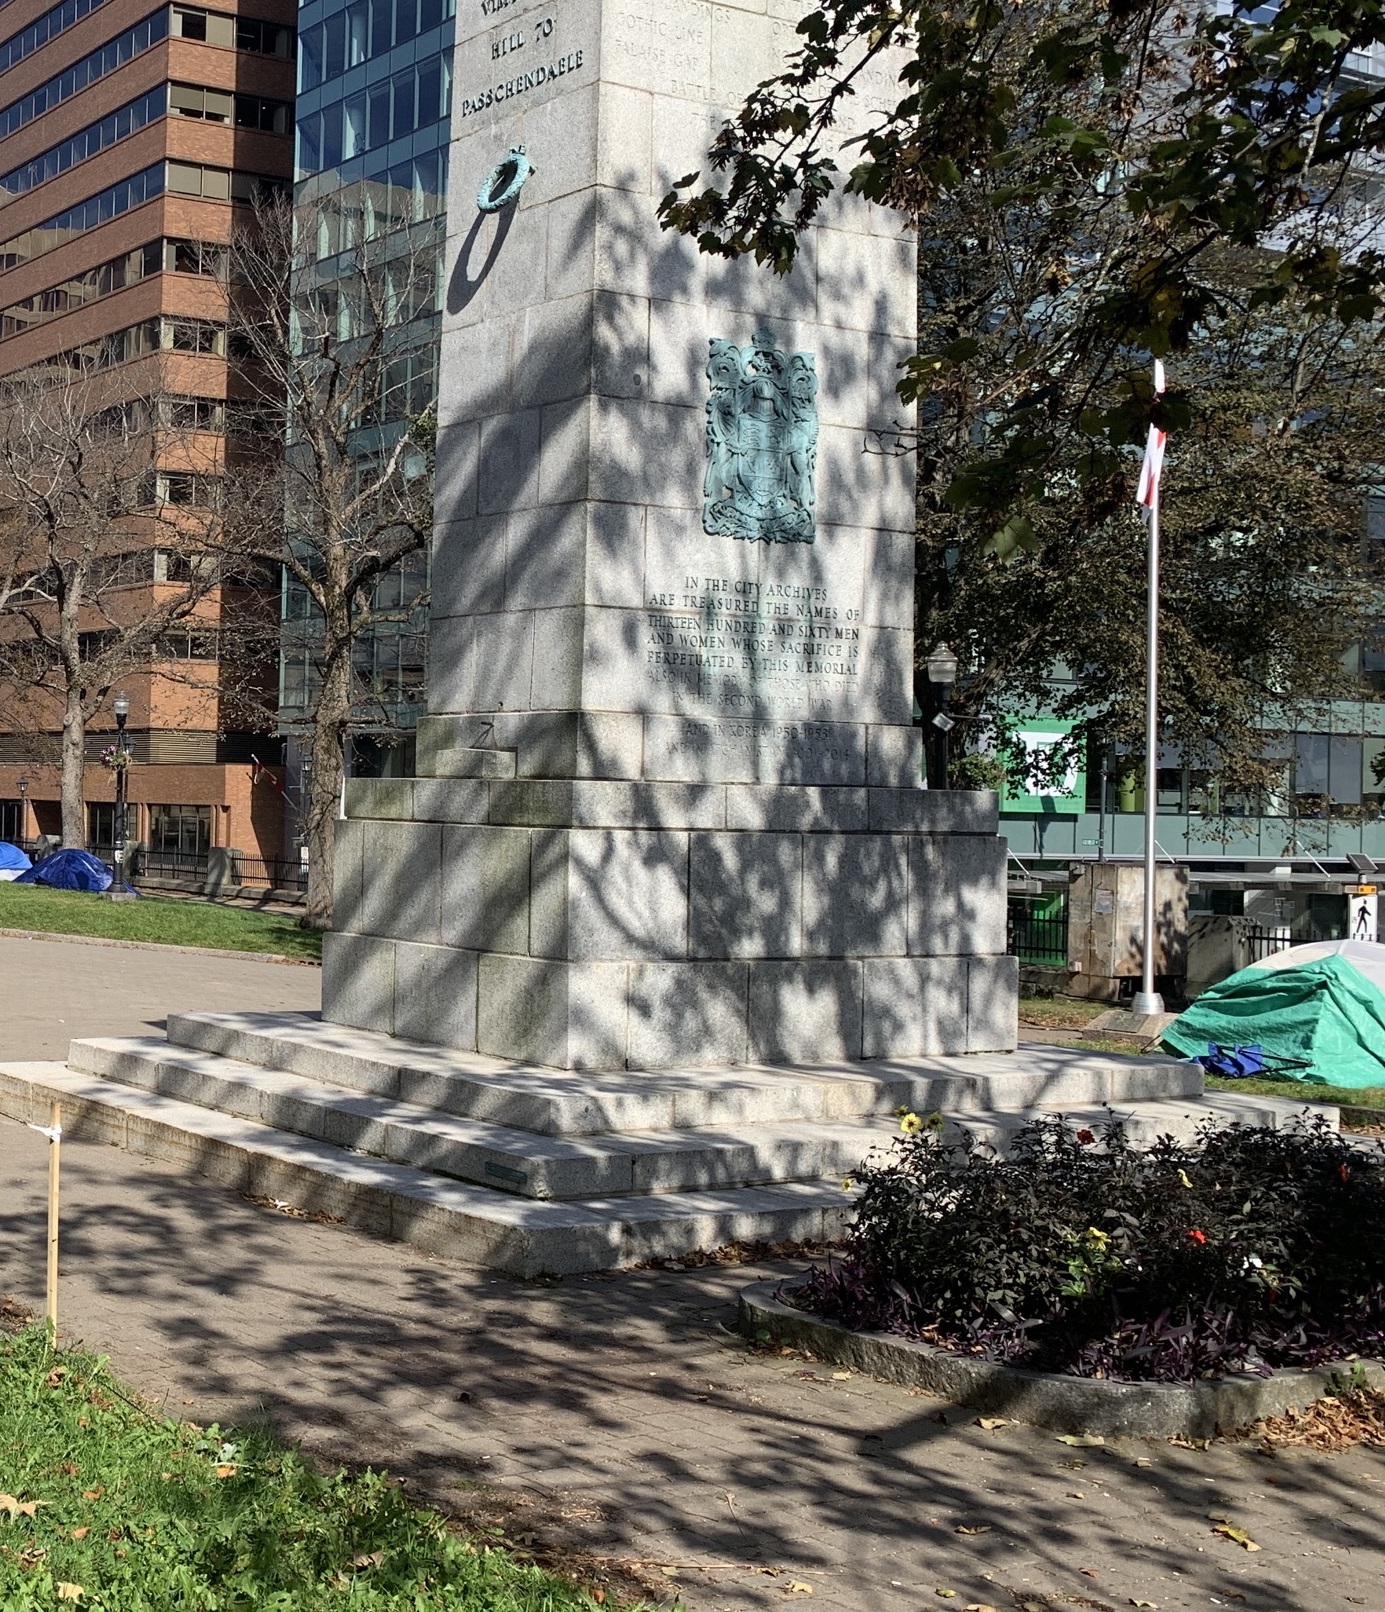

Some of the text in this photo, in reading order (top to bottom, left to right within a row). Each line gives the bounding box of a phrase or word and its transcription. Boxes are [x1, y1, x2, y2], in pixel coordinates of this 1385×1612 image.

[491, 31, 524, 60] HILL
[462, 49, 583, 118] PASSCHENDAELE
[671, 80, 716, 101] BATTLE
[685, 576, 827, 601] IN THE CITY ARCHIVES
[649, 594, 860, 621] ARE TREASURED THE NAMES OF
[648, 615, 859, 640] THIRTEEN HUNDRED AND SIXTY MEN
[647, 632, 858, 658] AND WOMEN WHOSE SACRIFICE IS
[647, 650, 858, 675] PERPETUATED BY THIS MEMORIAL
[690, 692, 712, 706] THE
[718, 694, 762, 708] SECOND
[767, 696, 803, 710] WORLD
[810, 698, 833, 711] WAR
[685, 722, 828, 740] AND IN KOREA 1950-1953
